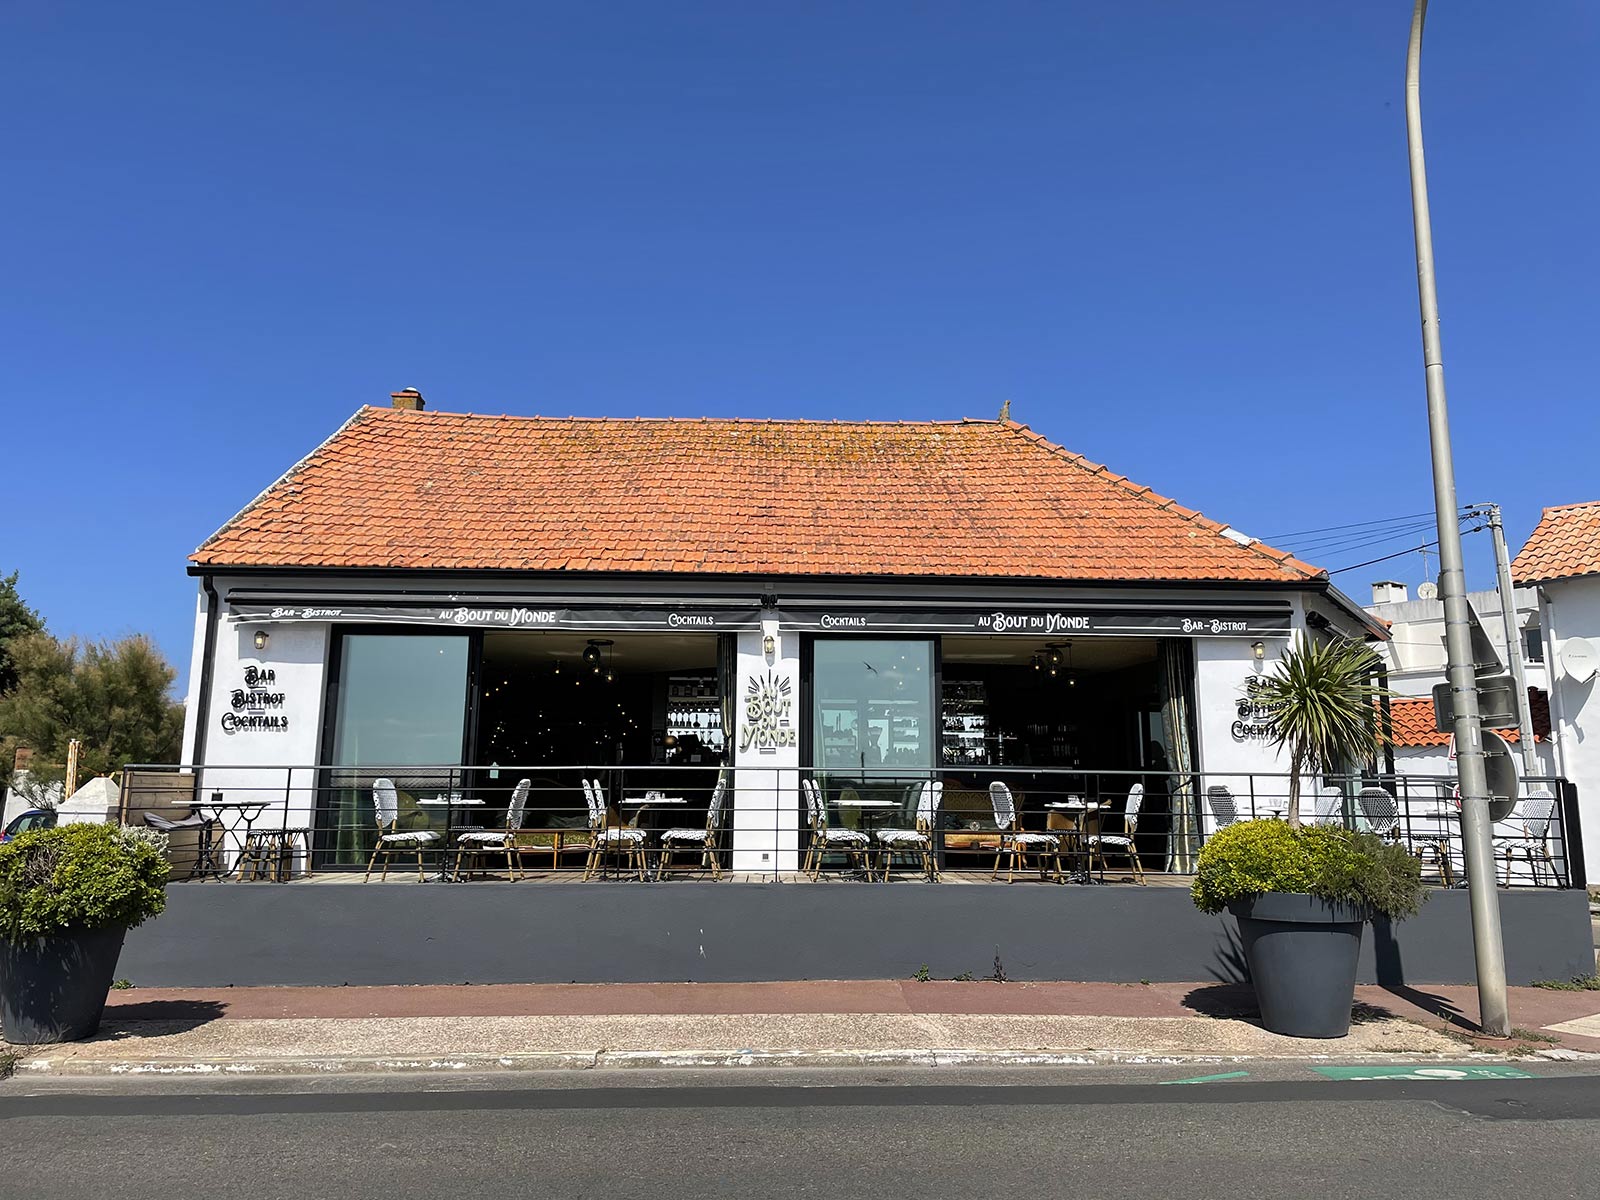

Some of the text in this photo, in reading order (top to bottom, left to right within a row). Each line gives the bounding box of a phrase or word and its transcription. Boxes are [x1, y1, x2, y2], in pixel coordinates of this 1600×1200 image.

[439, 606, 556, 626] AU BOUT DU MONDE
[668, 613, 714, 627] COCKTAILS
[821, 614, 866, 628] COCKTAILS
[978, 612, 1090, 633] AU BOUT DU MONDE
[243, 665, 276, 685] BAR
[230, 689, 285, 708] BISTROT
[744, 694, 791, 718] BOUT
[221, 712, 288, 731] COCKTAILS
[739, 724, 796, 748] MONDE
